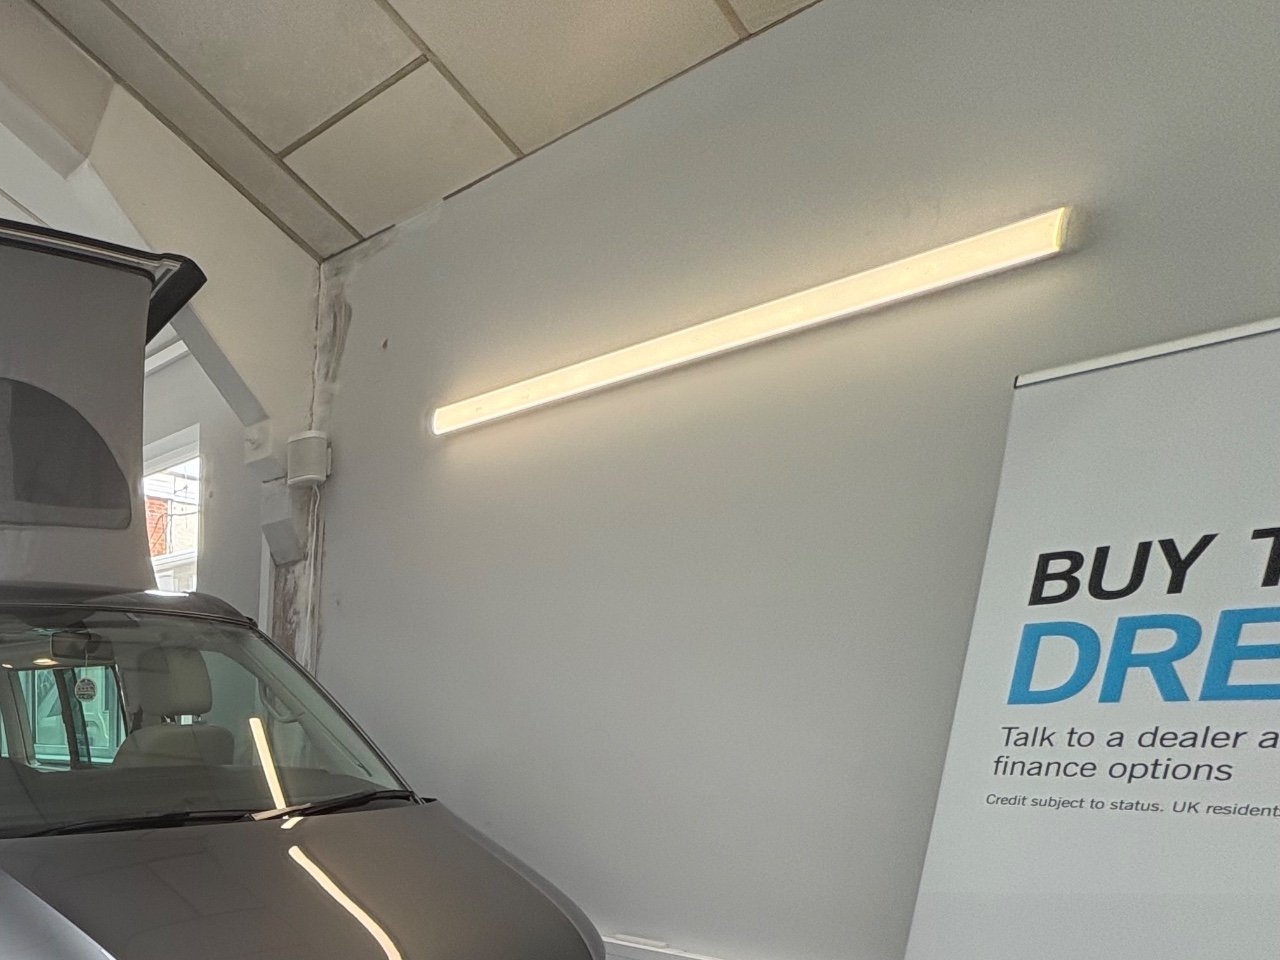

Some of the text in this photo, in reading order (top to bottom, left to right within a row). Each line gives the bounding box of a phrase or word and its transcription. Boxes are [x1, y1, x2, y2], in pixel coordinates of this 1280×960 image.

[1028, 533, 1219, 606] BUY
[1007, 606, 1280, 705] DRE
[1001, 726, 1057, 747] Talk
[1066, 727, 1095, 748] to
[1106, 731, 1124, 748] a
[1137, 725, 1248, 748] dealer
[993, 755, 1233, 784] finance options
[986, 793, 1280, 817] Credit subject to status. UK resident
